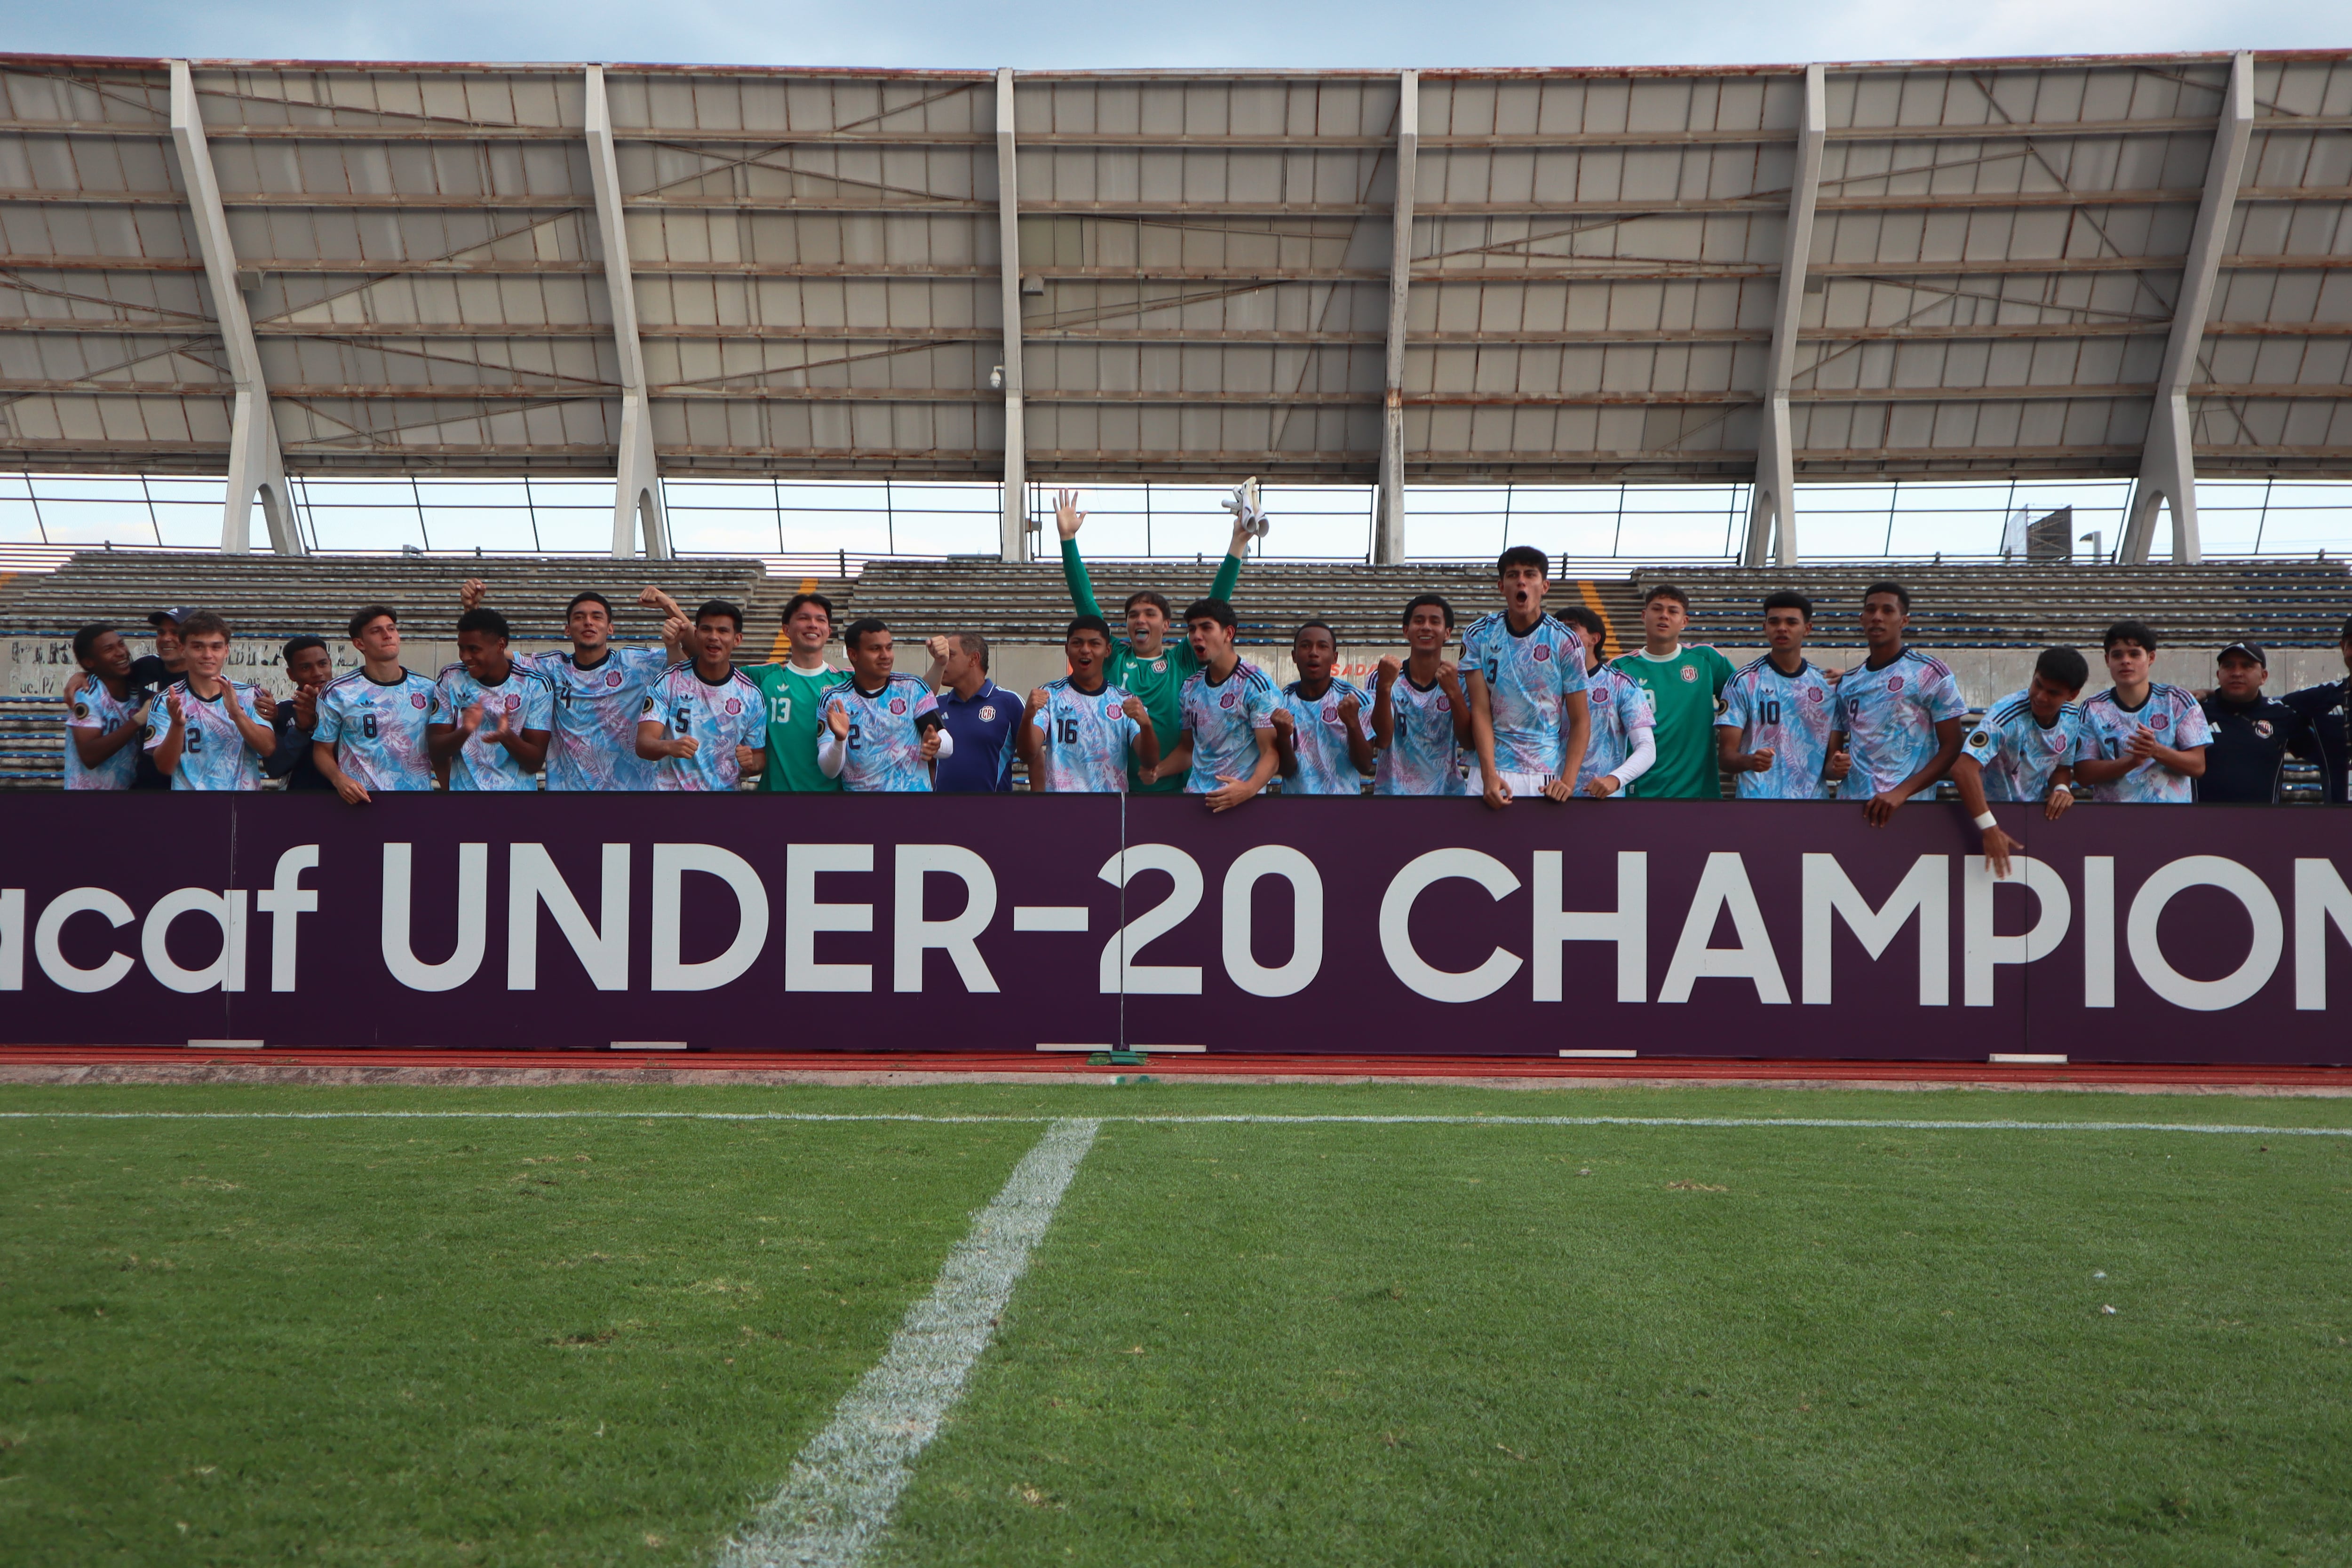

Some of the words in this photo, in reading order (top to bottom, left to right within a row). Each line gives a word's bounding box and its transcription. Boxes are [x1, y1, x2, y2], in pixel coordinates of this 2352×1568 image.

[1487, 659, 1498, 684] 3
[560, 687, 571, 709] 4
[771, 697, 791, 723] 13
[675, 708, 690, 733] 5
[1759, 700, 1780, 725] 10
[363, 714, 377, 738] 8
[849, 724, 861, 749] 2
[1057, 719, 1078, 744] 16
[0, 844, 319, 993] caf
[382, 843, 1323, 997] UNDER-20
